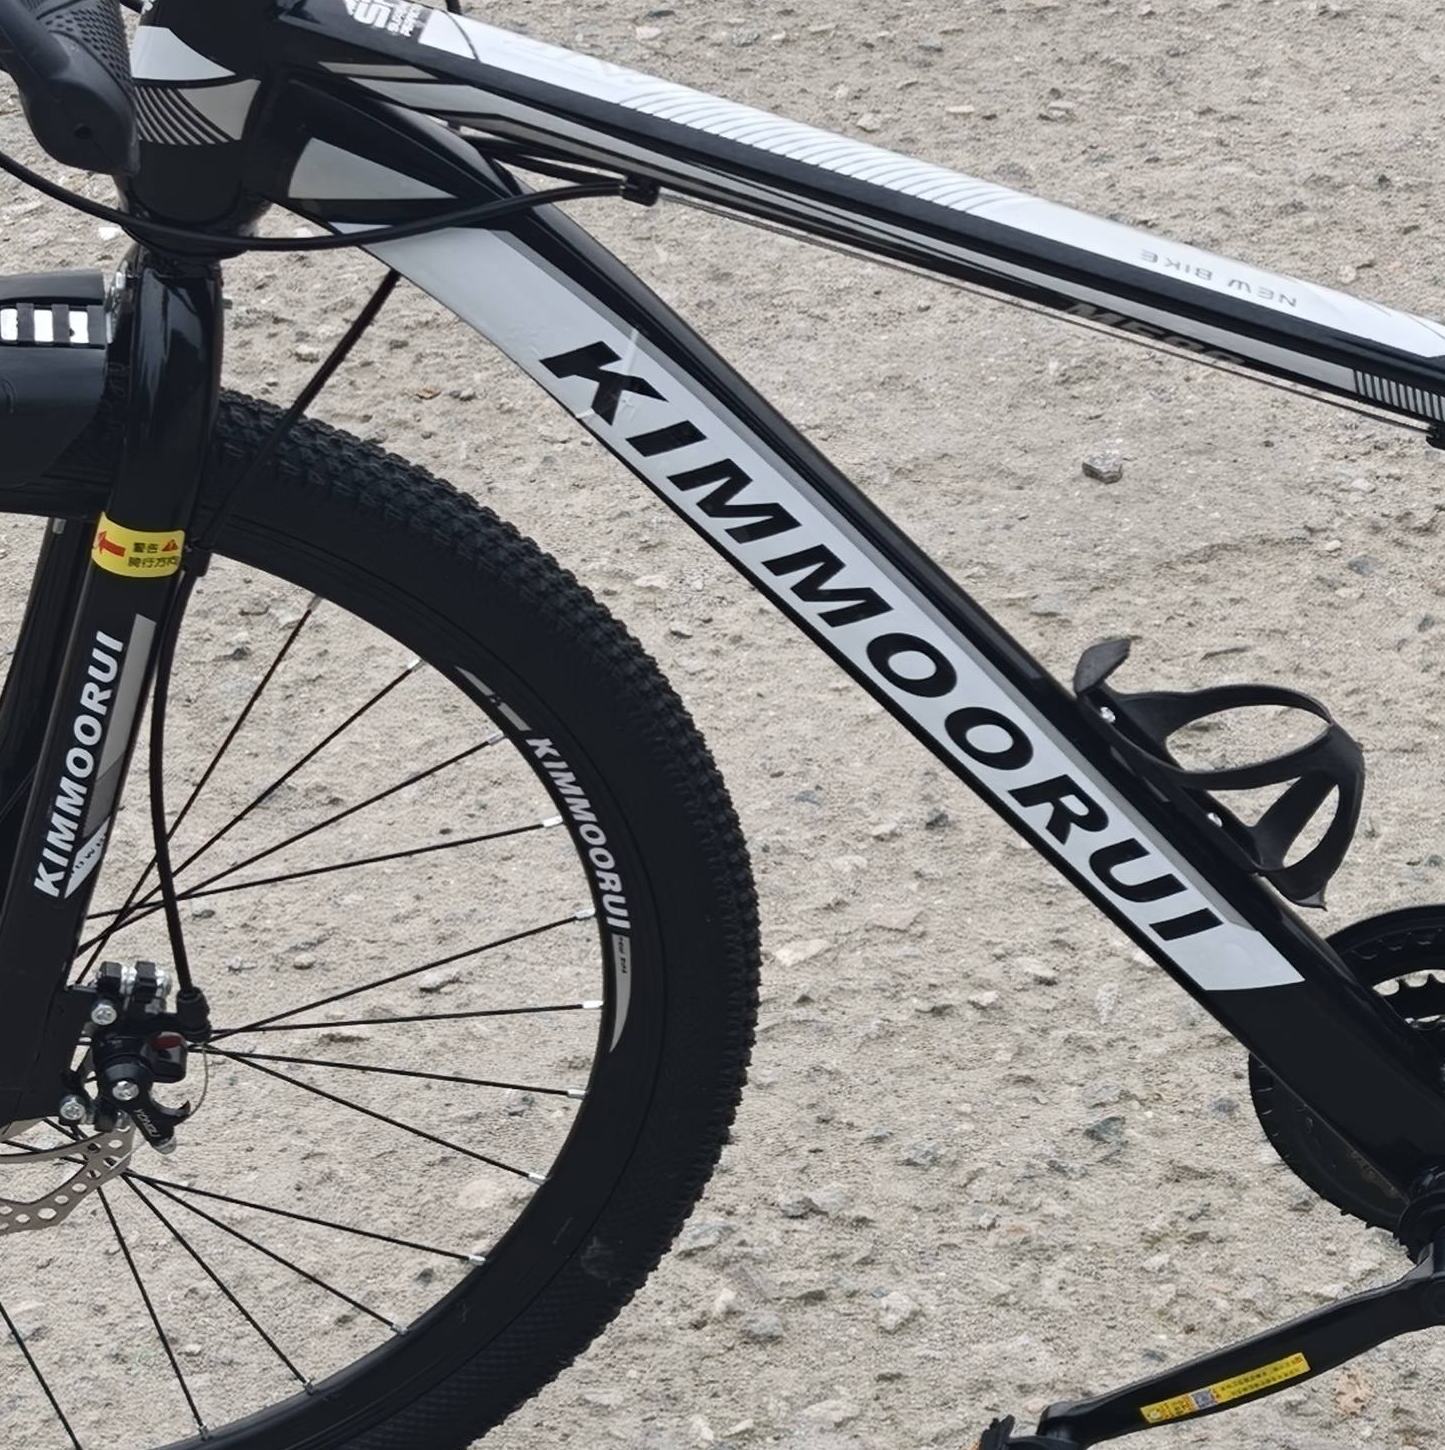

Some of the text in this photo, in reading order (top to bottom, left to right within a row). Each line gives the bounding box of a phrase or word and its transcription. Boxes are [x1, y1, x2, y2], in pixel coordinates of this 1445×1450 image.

[33, 629, 124, 899] KIMMOORUI
[539, 340, 1230, 942] KIMMOORUI
[525, 737, 631, 930] KIMMOORUI
